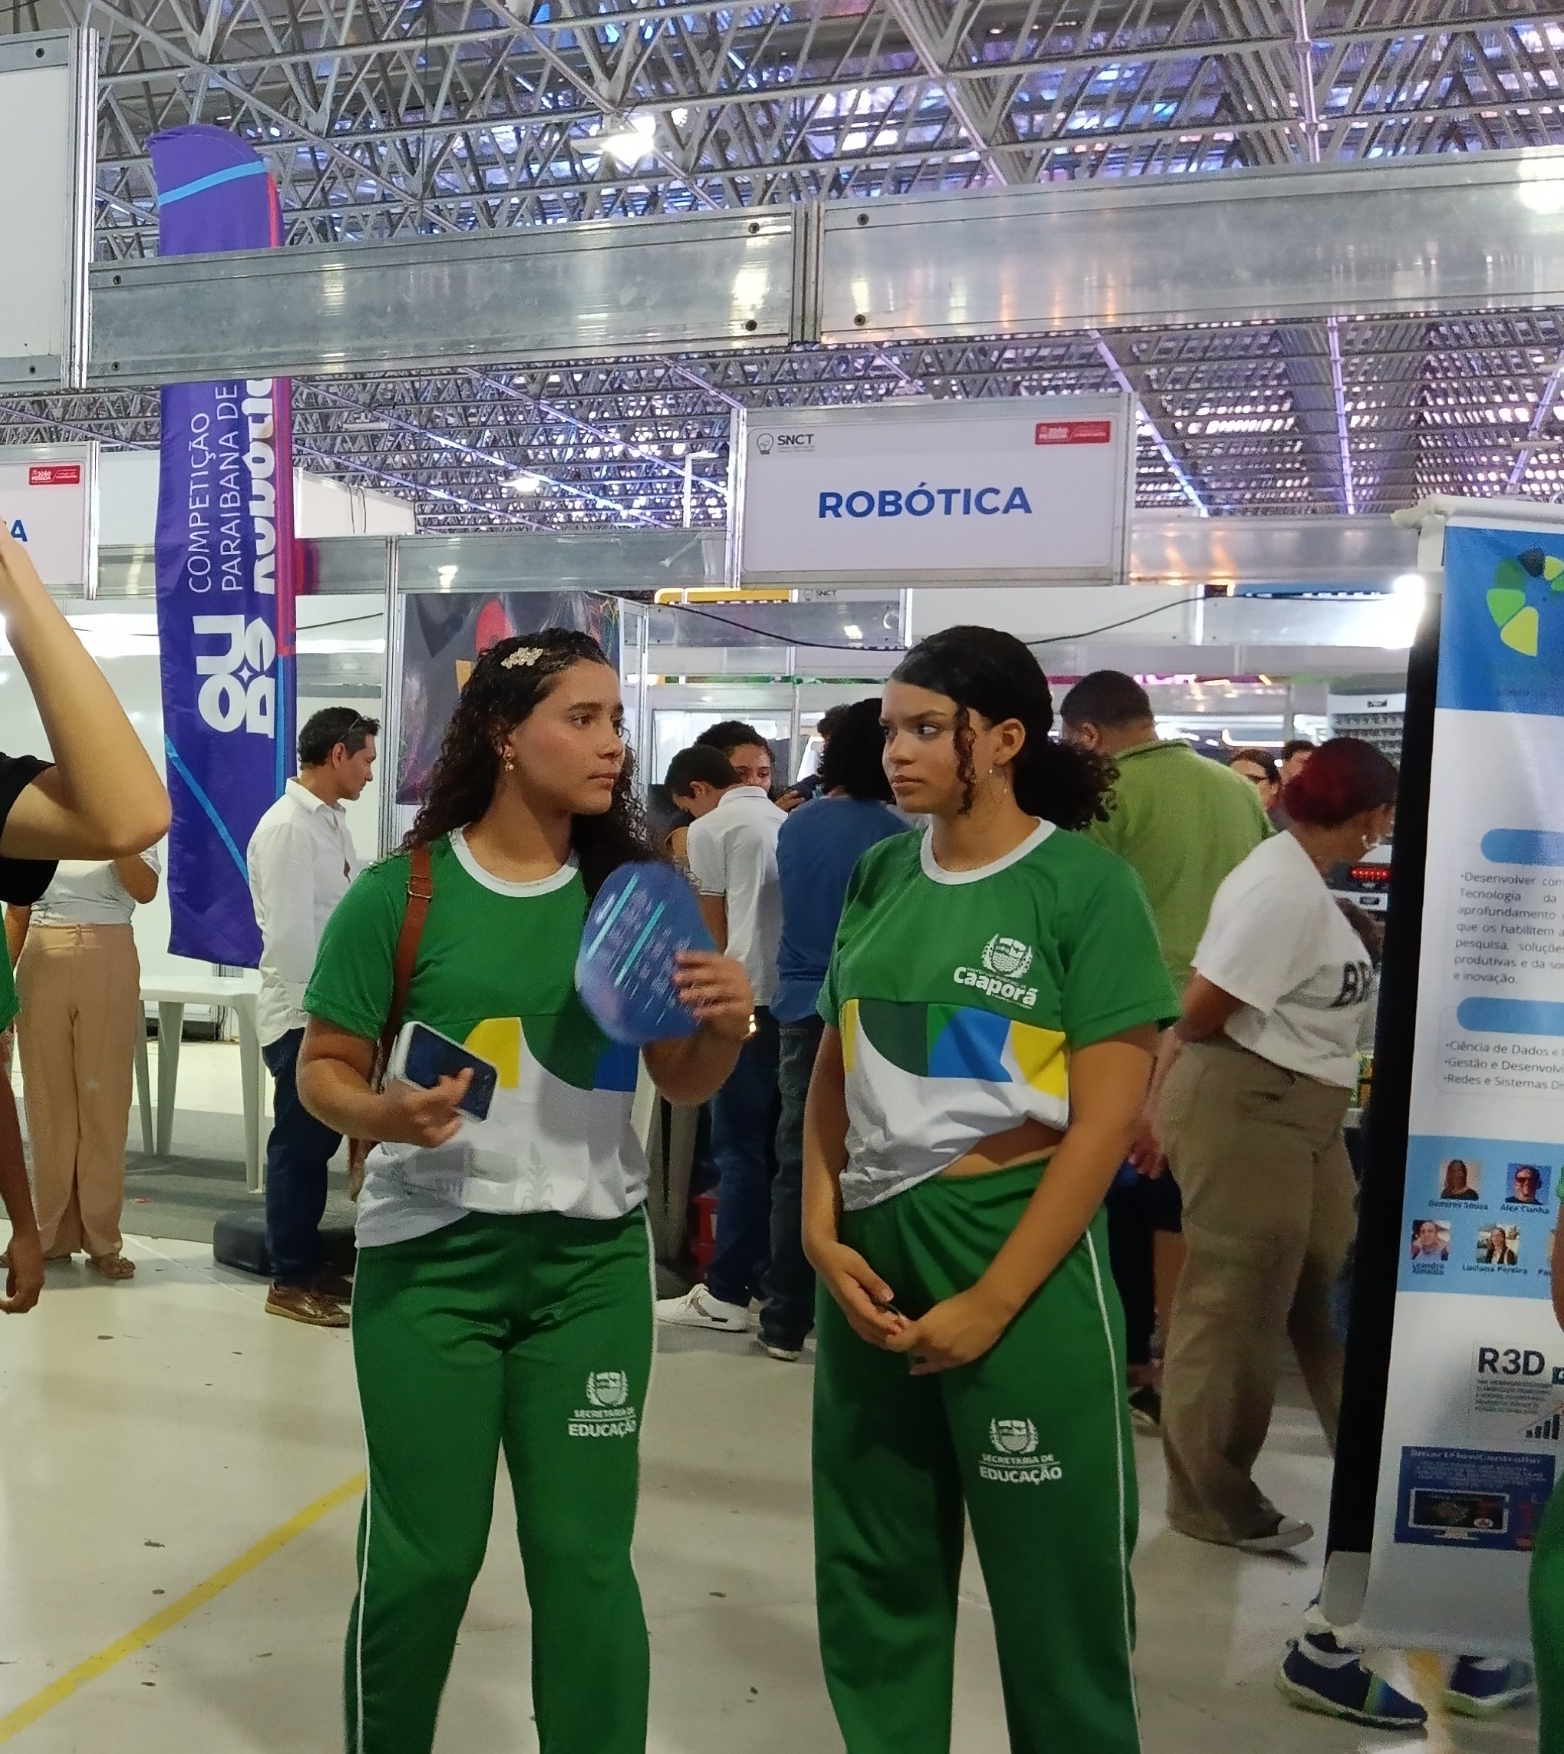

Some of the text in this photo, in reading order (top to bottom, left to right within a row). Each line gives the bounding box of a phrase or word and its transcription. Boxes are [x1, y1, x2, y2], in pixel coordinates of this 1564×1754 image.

[777, 433, 815, 446] SNCT
[215, 384, 244, 593] PARAIBANA DE
[189, 412, 216, 594] COMPETIÇÃO
[818, 481, 1033, 519] ROBÓTICA
[1464, 872, 1536, 886] Desenvolver
[1460, 888, 1557, 904] Tecnologia da
[1457, 906, 1557, 920] aprofundamento
[1456, 923, 1478, 934] que
[1482, 924, 1497, 933] os
[1501, 923, 1555, 936] habilitem
[1455, 939, 1510, 952] pesquisa,
[1454, 955, 1517, 968] produtivas
[1531, 959, 1545, 969] da
[1453, 973, 1460, 981] e
[953, 966, 1040, 1007] Caaporã
[1449, 1040, 1490, 1052] Ciência
[1493, 1043, 1508, 1054] de
[1511, 1044, 1549, 1056] Dados
[1448, 1056, 1488, 1069] Gestão
[1491, 1061, 1498, 1069] e
[1447, 1073, 1482, 1085] Redes
[1484, 1077, 1492, 1086] e
[1494, 1076, 1549, 1090] Sistemas
[1478, 1346, 1545, 1376] R3D
[982, 1453, 1055, 1465] SECRETARIA DE
[979, 1464, 1064, 1486] EDUCAÇÃO
